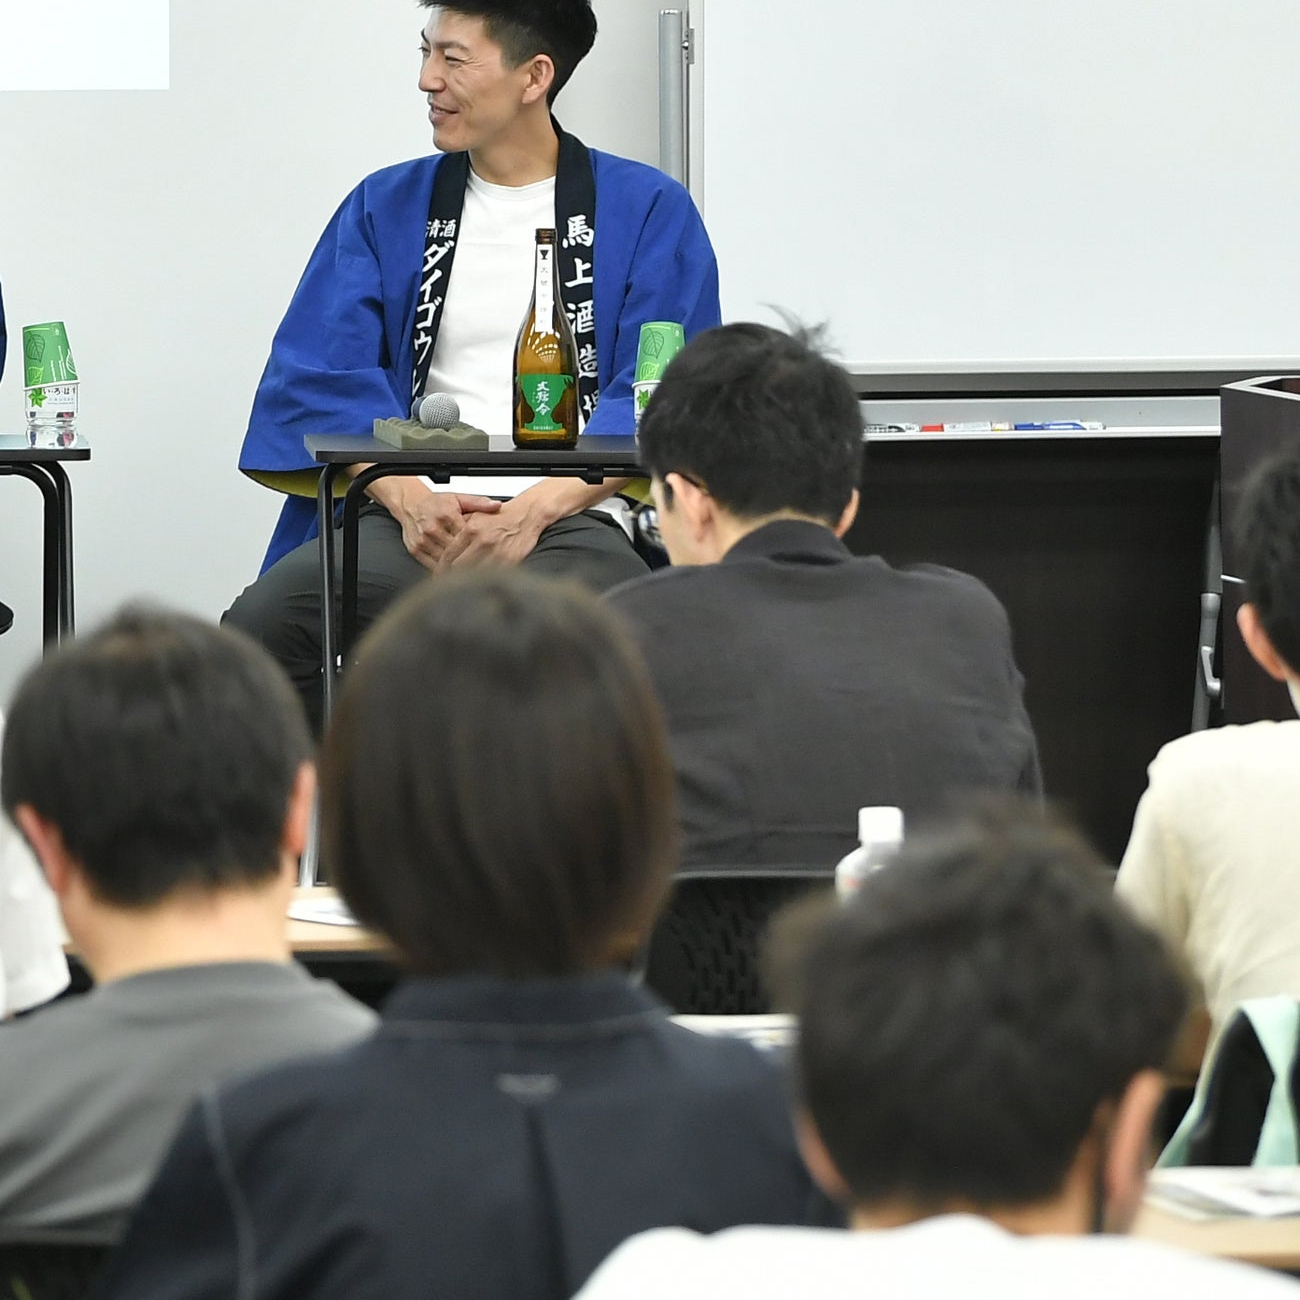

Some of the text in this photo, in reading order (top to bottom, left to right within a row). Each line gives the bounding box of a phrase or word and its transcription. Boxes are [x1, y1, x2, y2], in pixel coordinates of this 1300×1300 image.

[426, 219, 456, 238] 清酒
[412, 240, 454, 400] ダイゴウレ
